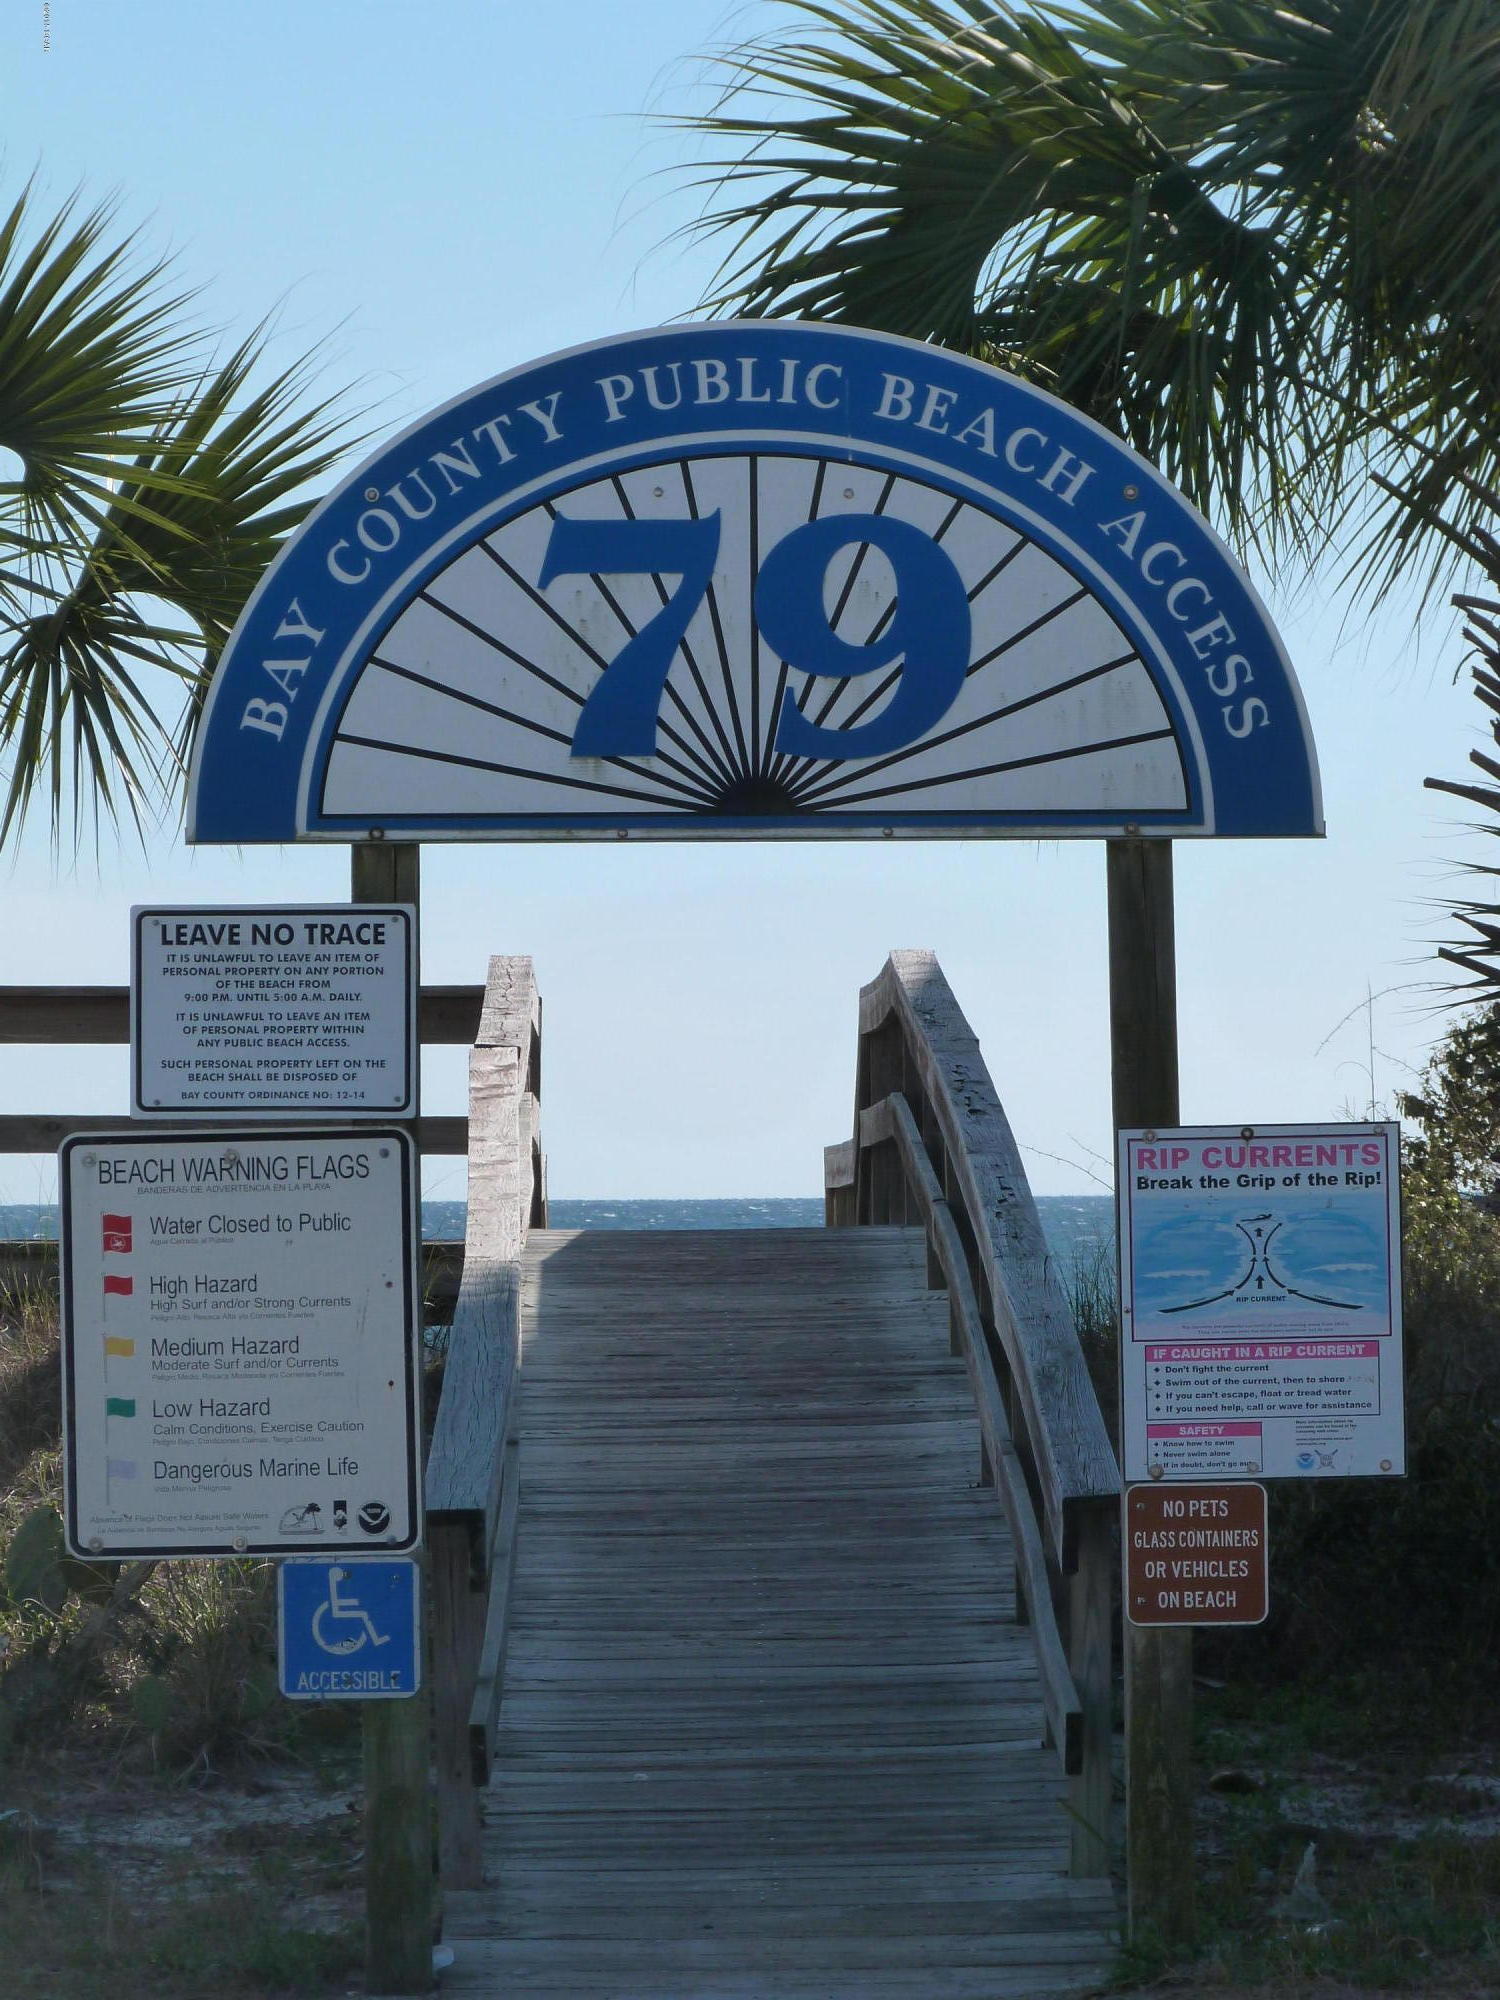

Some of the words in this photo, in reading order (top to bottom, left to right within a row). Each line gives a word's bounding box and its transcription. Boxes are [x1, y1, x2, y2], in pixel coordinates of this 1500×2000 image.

[239, 597, 327, 743] BAY
[326, 391, 565, 586] COUNTY
[595, 356, 843, 423] PUBLIC
[873, 371, 1098, 507] BEACH
[1097, 509, 1271, 739] ACCESS
[537, 507, 972, 760] 79
[161, 924, 240, 945] LEAVE
[252, 923, 294, 945] NO
[304, 923, 385, 945] TRACE
[167, 954, 176, 962] IT
[180, 954, 190, 962] IS
[193, 954, 255, 962] UNLAWFUL
[259, 954, 273, 962] TO
[278, 954, 311, 962] LEAVE
[315, 954, 331, 962] AN
[335, 954, 360, 962] ITEM
[365, 954, 380, 962] OF
[163, 967, 220, 975] PERSONAL
[225, 967, 280, 975] PROPERTY
[284, 967, 301, 975] ON
[306, 967, 329, 975] ANY
[333, 967, 384, 975] PORTION
[216, 980, 231, 988] OF
[234, 980, 255, 988] THE
[259, 980, 294, 988] BEACH
[299, 980, 330, 988] FROM
[184, 993, 209, 1001] 9:00
[213, 993, 232, 1001] P.M.
[237, 993, 270, 1001] UNTIL
[274, 993, 298, 1001] 5:00
[302, 993, 325, 1001] A.M.
[329, 993, 362, 1001] DAILY.
[176, 1013, 186, 1021] IT
[190, 1013, 199, 1021] IS
[203, 1013, 264, 1021] UNLAWFUL
[268, 1013, 283, 1021] TO
[287, 1013, 320, 1021] LEAVE
[324, 1013, 340, 1021] AN
[345, 1013, 370, 1021] ITEM
[183, 1026, 198, 1034] OF
[201, 1026, 259, 1034] PERSONAL
[263, 1026, 319, 1034] PROPERTY
[322, 1026, 364, 1034] WITHIN
[197, 1039, 220, 1047] ANY
[224, 1039, 263, 1047] PUBLIC
[267, 1039, 302, 1047] BEACH
[306, 1039, 349, 1047] ACCESS.
[161, 1060, 190, 1069] SUCH
[195, 1060, 252, 1069] PERSONAL
[257, 1060, 312, 1069] PROPERTY
[316, 1060, 339, 1069] LEFT
[344, 1060, 360, 1069] ON
[365, 1060, 386, 1069] THE
[188, 1073, 224, 1082] BEACH
[228, 1073, 261, 1082] SHALL
[266, 1073, 279, 1082] BE
[284, 1073, 338, 1082] DISPOSED
[342, 1073, 357, 1082] OF
[1137, 1148, 1189, 1169] RIP
[1202, 1144, 1380, 1168] CURRENTS
[99, 1158, 174, 1184] BEACH
[183, 1157, 288, 1181] WARNING
[297, 1154, 369, 1180] FLAGS
[1137, 1176, 1193, 1190] Break
[1200, 1176, 1230, 1188] the
[1237, 1174, 1275, 1190] Grip
[1282, 1173, 1301, 1186] of
[1308, 1173, 1338, 1186] the
[1345, 1172, 1381, 1188] Rip!
[150, 1216, 202, 1235] Water
[208, 1215, 270, 1233] Closed
[277, 1216, 292, 1232] to
[300, 1212, 351, 1231] Public
[150, 1277, 188, 1298] High
[195, 1274, 257, 1293] Hazard
[151, 1300, 177, 1313] High
[182, 1299, 209, 1310] Surf
[212, 1298, 250, 1310] and/or
[254, 1298, 294, 1312] Strong
[299, 1296, 351, 1308] Currents
[152, 1338, 224, 1357] Medium
[232, 1336, 300, 1354] Hazard
[1154, 1350, 1166, 1358] IF
[1171, 1348, 1230, 1358] CAUGHT
[1236, 1348, 1250, 1357] IN
[1254, 1347, 1264, 1357] A
[1269, 1346, 1292, 1356] RIP
[1296, 1344, 1365, 1356] CURRENT
[152, 1360, 209, 1370] Moderate
[214, 1359, 240, 1369] Surf
[244, 1358, 282, 1369] and/or
[286, 1357, 339, 1368] Currents
[1165, 1366, 1189, 1374] Don't
[1192, 1366, 1214, 1374] fight
[1234, 1364, 1269, 1372] current
[152, 1400, 192, 1418] Low
[200, 1398, 270, 1416] Hazard
[153, 1424, 185, 1435] Calm
[261, 1422, 313, 1433] Exercise
[317, 1421, 364, 1432] Caution
[1179, 1426, 1224, 1435] SAFETY
[154, 1459, 252, 1483] Dangerous
[260, 1458, 320, 1476] Marine
[328, 1457, 359, 1475] Life
[1164, 1502, 1184, 1517] NO
[1189, 1500, 1228, 1517] PETS
[1134, 1532, 1175, 1548] GLASS
[1179, 1530, 1258, 1547] CONTAINERS
[1145, 1562, 1166, 1578] OR
[1172, 1560, 1248, 1578] VEHICLES
[1158, 1592, 1180, 1608] ON
[1184, 1591, 1236, 1608] BEACH
[298, 1671, 400, 1690] ACCESSIBLE
